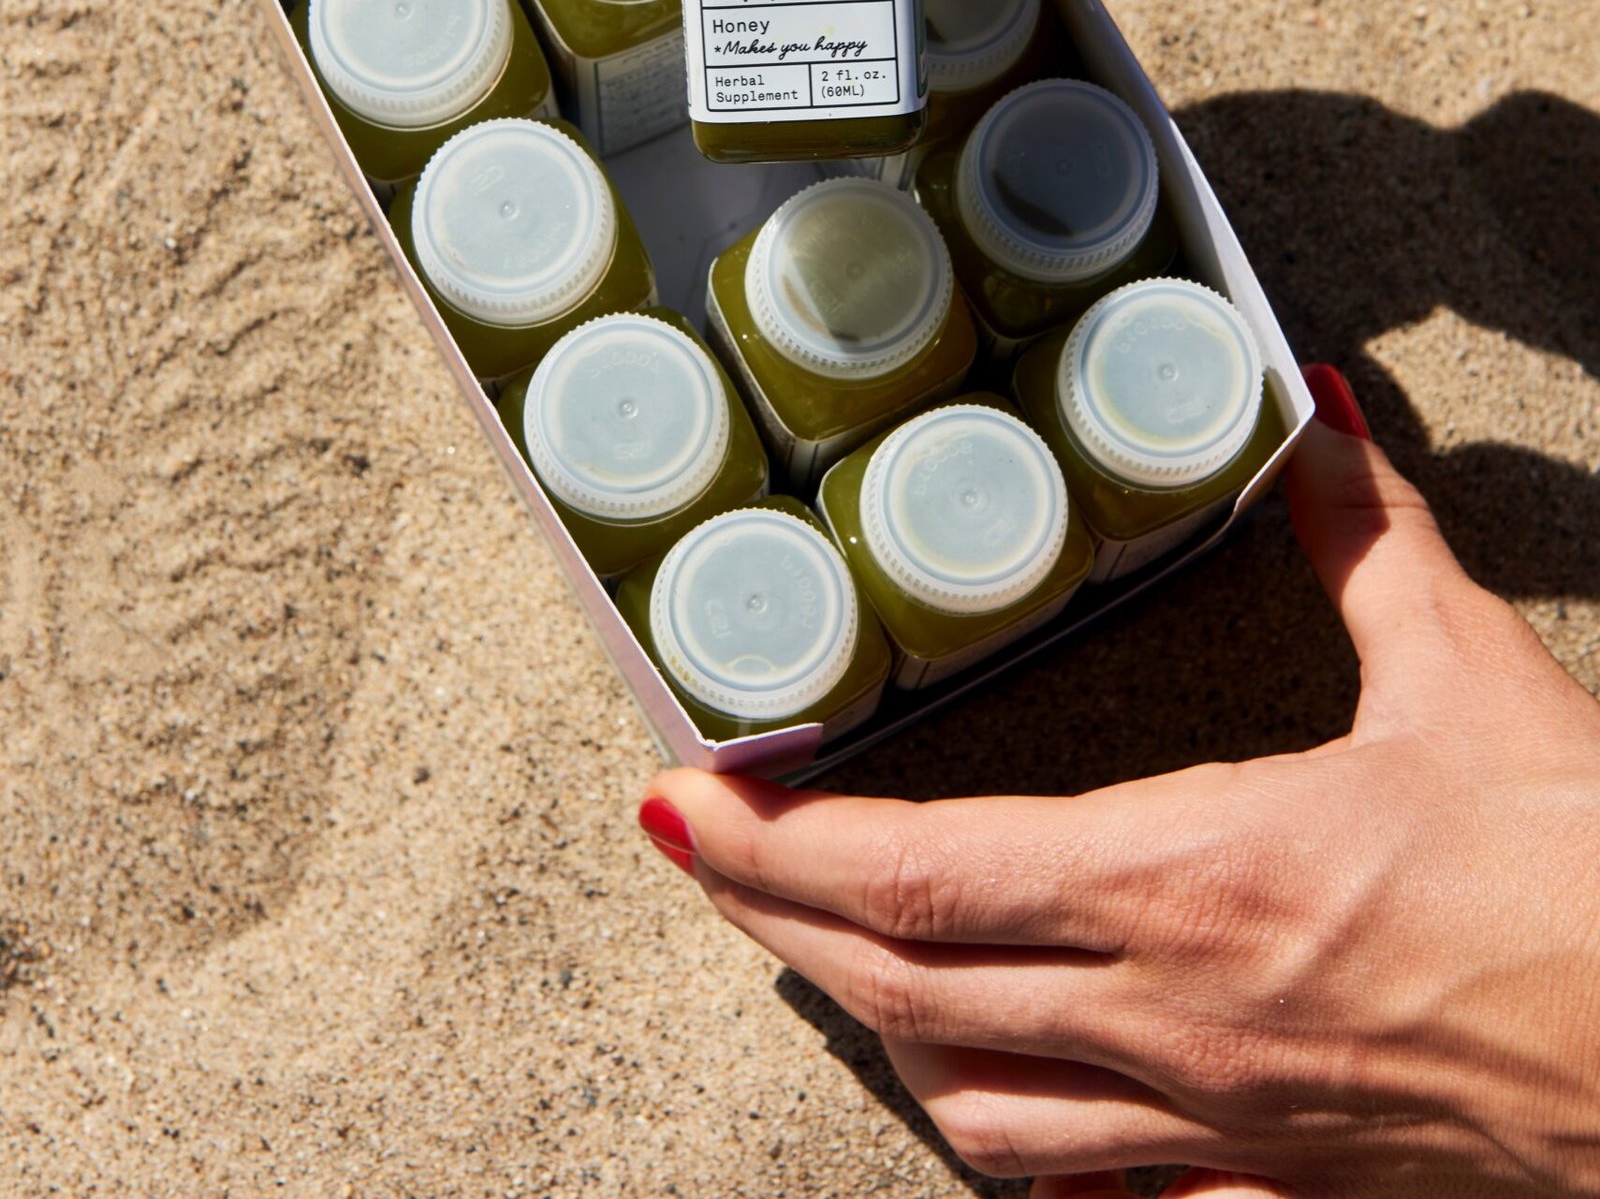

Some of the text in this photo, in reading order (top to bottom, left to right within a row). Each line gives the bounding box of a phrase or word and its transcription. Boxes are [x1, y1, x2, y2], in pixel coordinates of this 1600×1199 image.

[713, 19, 770, 35] Honey
[778, 43, 811, 60] you
[814, 36, 868, 58] happy
[716, 74, 764, 87] Herbal
[822, 71, 828, 81] 2
[717, 90, 798, 104] Supplement
[822, 84, 864, 98] (60ML)
